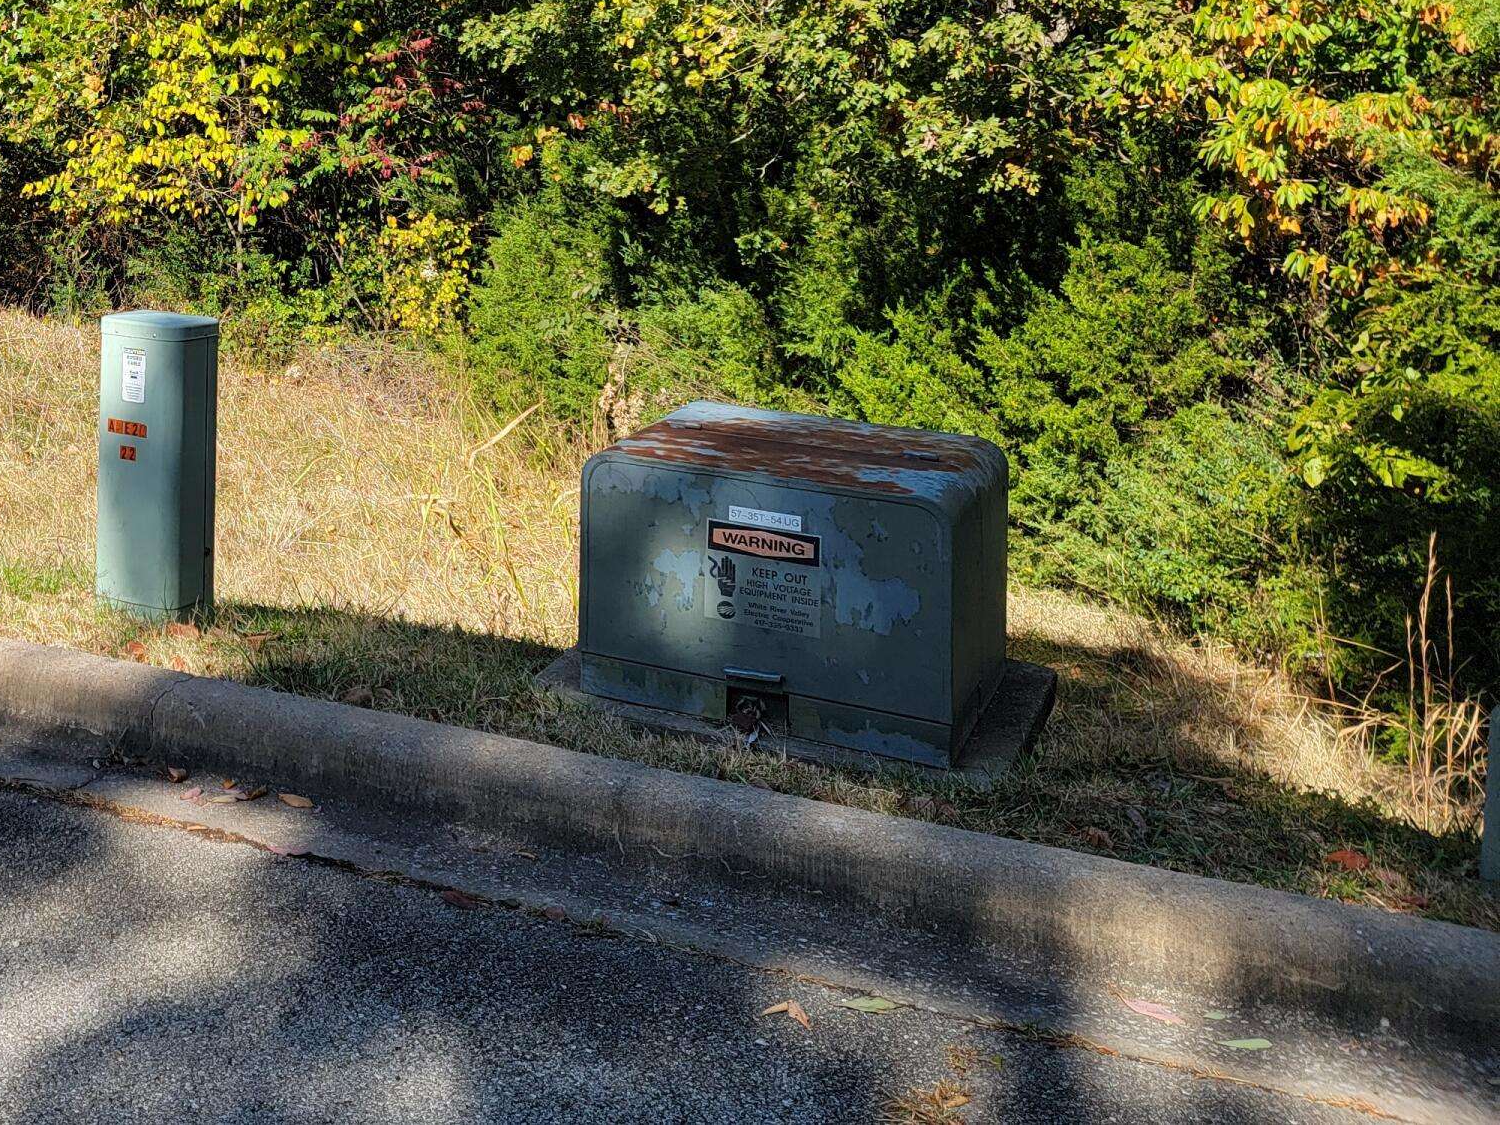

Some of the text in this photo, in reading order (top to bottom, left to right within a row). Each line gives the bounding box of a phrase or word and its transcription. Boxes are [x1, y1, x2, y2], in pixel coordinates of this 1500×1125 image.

[121, 447, 135, 460] 22
[722, 532, 805, 555] WARNING
[752, 567, 807, 585] KEEP OUT
[740, 587, 819, 607] EQUIPMENT INSIDE
[747, 579, 812, 597] HIGH VOLTAGE
[748, 602, 767, 611] White
